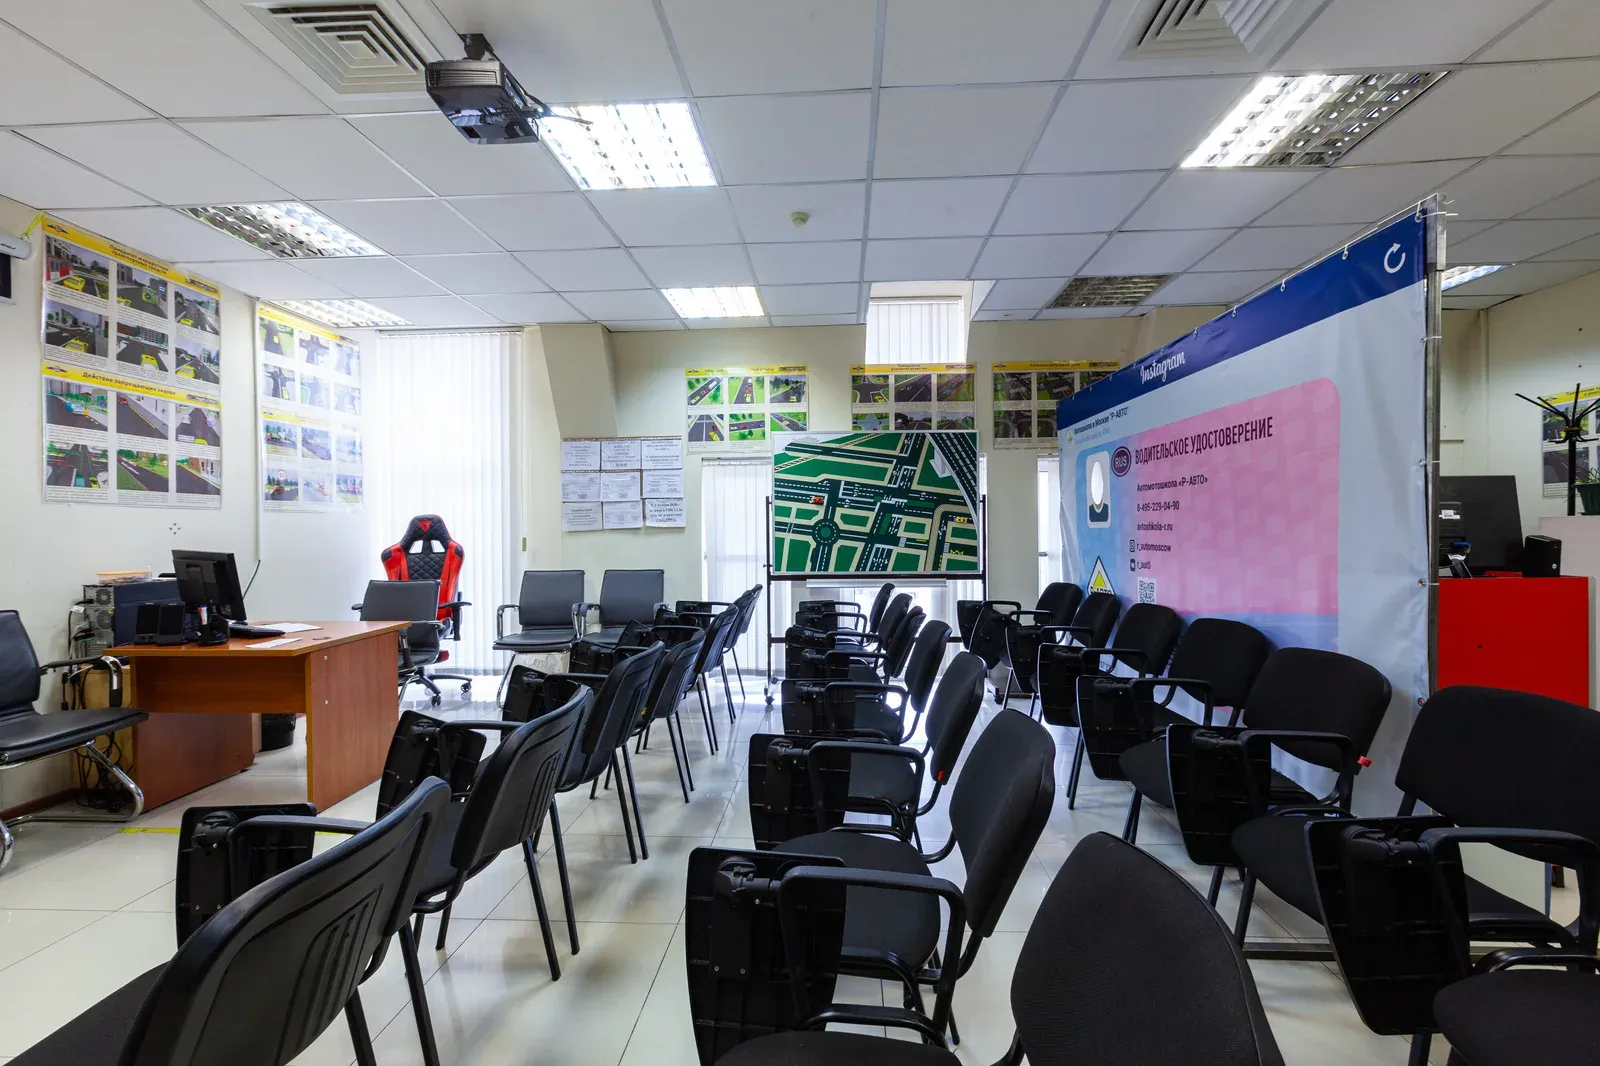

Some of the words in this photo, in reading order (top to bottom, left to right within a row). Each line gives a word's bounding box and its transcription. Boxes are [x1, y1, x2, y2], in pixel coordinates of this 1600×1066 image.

[1140, 351, 1187, 385] Instagram
[82, 371, 114, 383] Действие
[1135, 437, 1189, 465] ВОДИТЕЛЬСКОЕ
[1190, 416, 1273, 454] УДОСТОВЕРЕНИЕ
[1115, 455, 1128, 468] RUS
[1137, 480, 1178, 492] Автомотошкола
[1137, 500, 1180, 512] 8-495-229-04-90
[1137, 522, 1173, 531] avtoshkola-r.ru
[1136, 542, 1171, 552] r_automoscow
